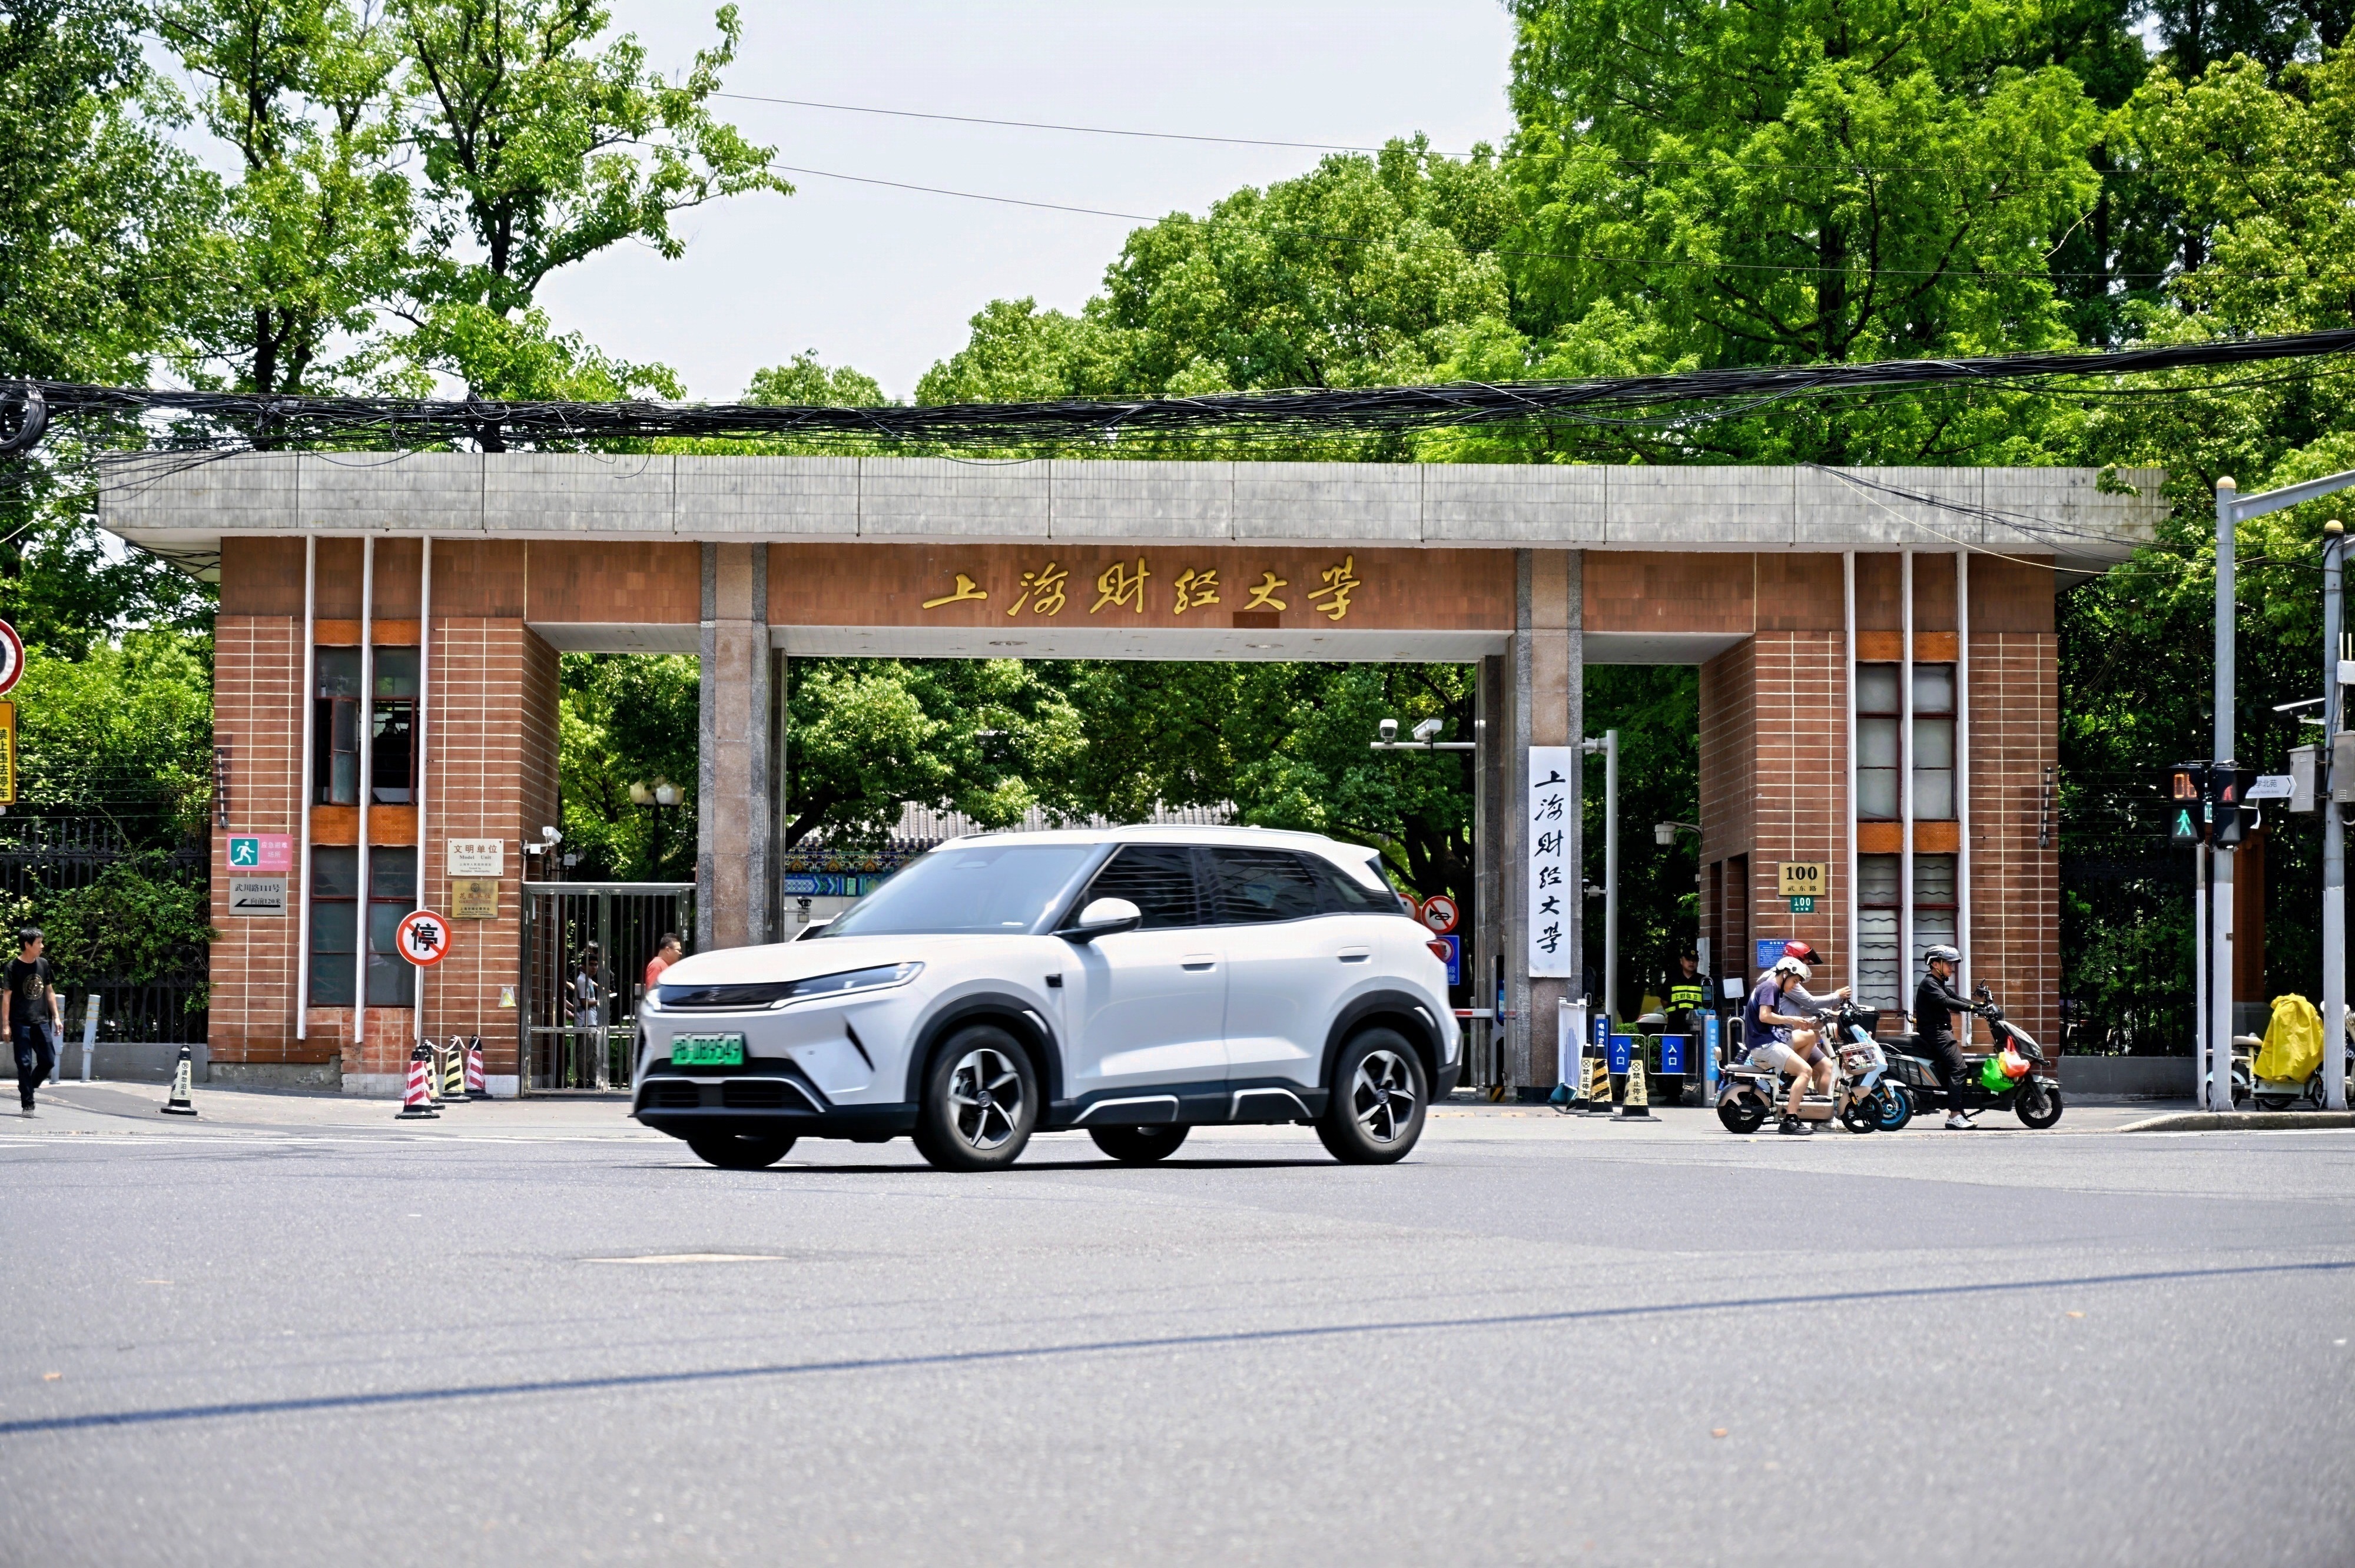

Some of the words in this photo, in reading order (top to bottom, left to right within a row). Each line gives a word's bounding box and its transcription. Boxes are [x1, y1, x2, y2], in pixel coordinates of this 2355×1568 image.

[922, 554, 1361, 621] 上海财经大学
[2253, 779, 2277, 788] 学北苑
[453, 844, 497, 854] 文明单位
[1534, 770, 1567, 954] 上海财经大学
[1786, 866, 1818, 880] 100
[235, 883, 280, 893] 武川路111号
[1794, 897, 1811, 906] 100
[410, 922, 438, 952] 停
[1674, 992, 1698, 1000] 上财保卫
[1616, 1043, 1626, 1065] 入口
[1668, 1044, 1677, 1066] 入口
[180, 1069, 188, 1096] 请勿泊车
[1582, 1069, 1590, 1096] 禁止停车
[1632, 1072, 1641, 1103] 禁止停车
